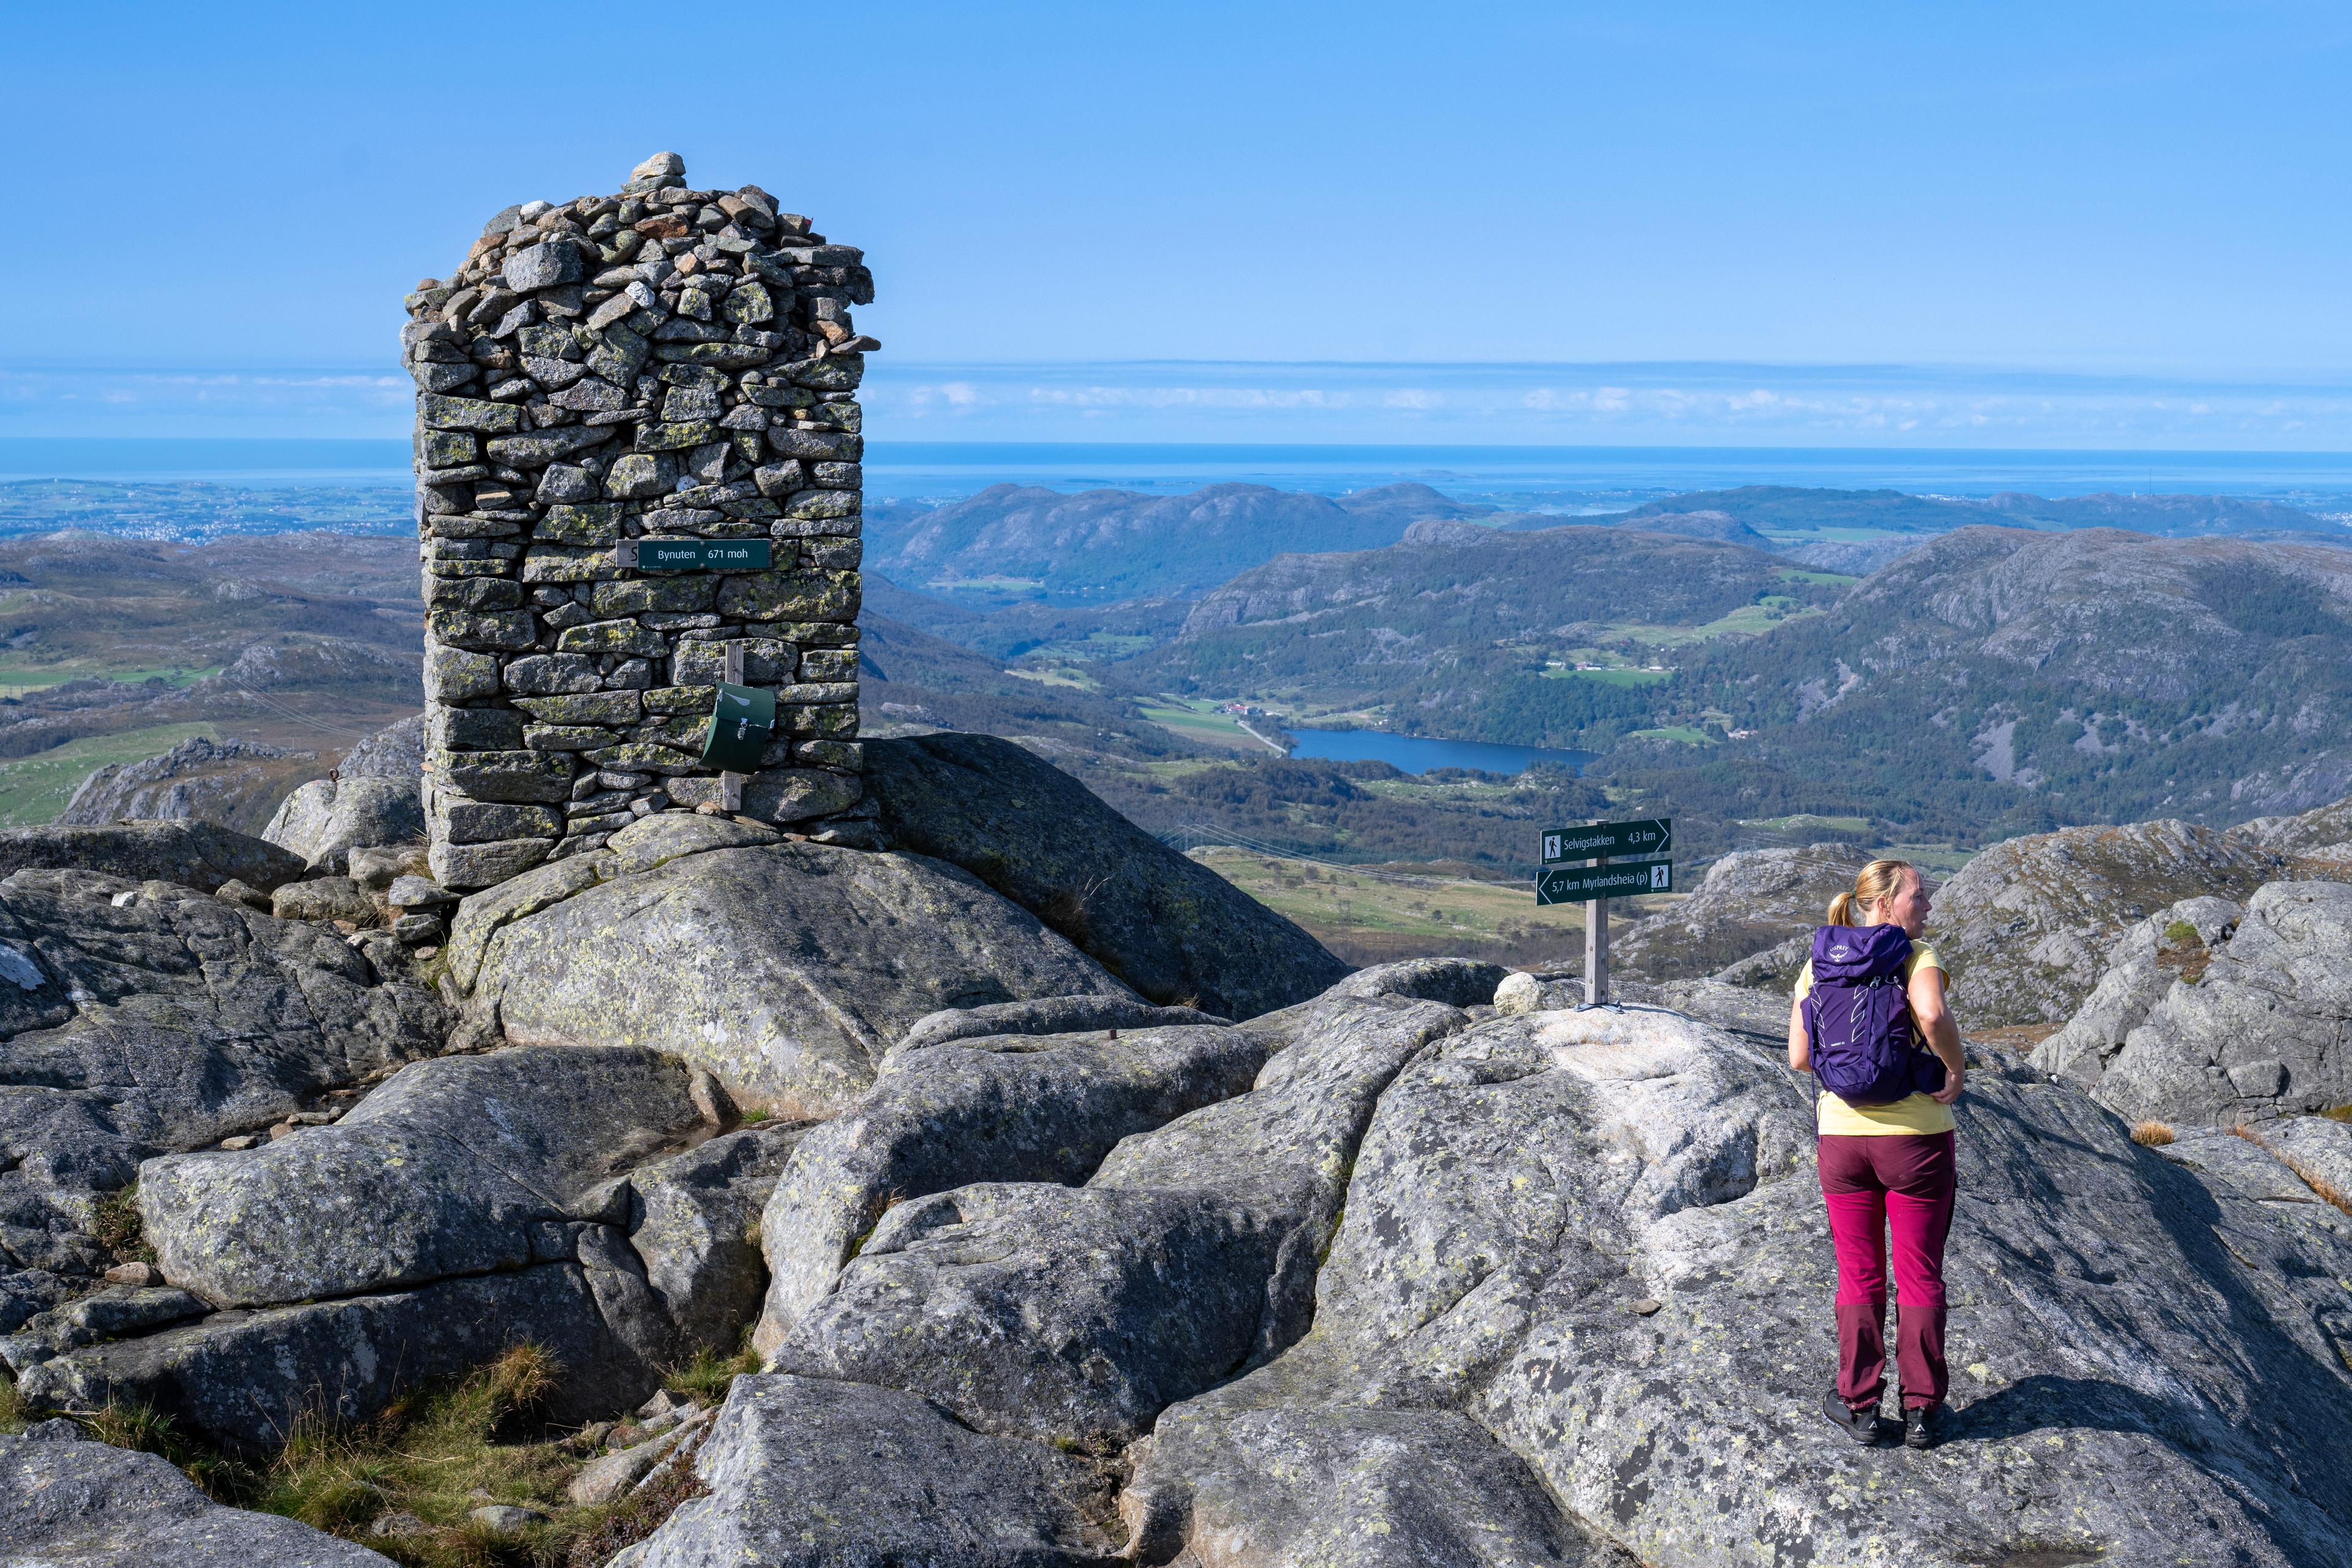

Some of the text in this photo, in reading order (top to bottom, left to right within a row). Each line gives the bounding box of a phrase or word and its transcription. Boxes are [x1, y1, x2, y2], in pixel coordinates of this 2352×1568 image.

[658, 549, 748, 561] Bynuten 671 moh
[1564, 830, 1656, 851] Selvigstakken 4,3 km
[1552, 871, 1648, 894] 5,7 km Myrlandsheia (p)
